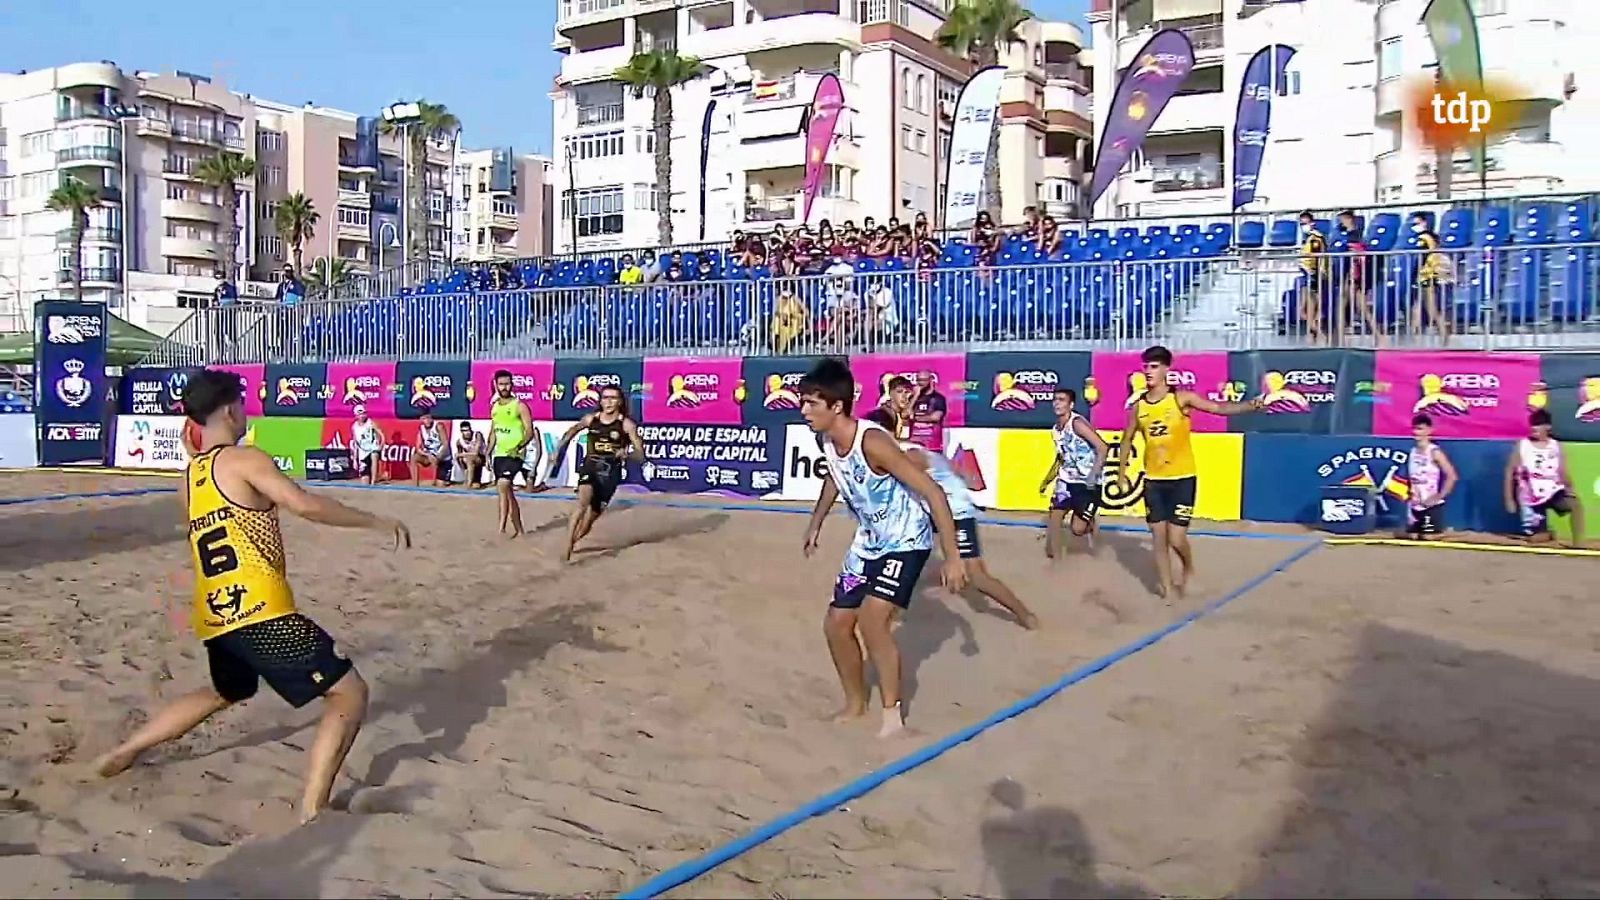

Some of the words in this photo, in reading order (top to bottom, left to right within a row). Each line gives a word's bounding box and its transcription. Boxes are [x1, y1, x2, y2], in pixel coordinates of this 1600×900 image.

[288, 377, 311, 387] ARENA
[355, 376, 381, 387] ARENA
[424, 375, 451, 386] ARENA
[512, 375, 534, 386] RENA
[588, 375, 621, 385] ARENA
[684, 374, 719, 385] ARENA
[1014, 371, 1059, 384] ARENA
[1166, 371, 1196, 384] ENA
[1284, 370, 1335, 384] ARENA
[1442, 374, 1500, 388] ARENA
[133, 381, 163, 391] MELILLA
[133, 393, 157, 402] SPORT
[697, 392, 718, 400] TOUR
[1304, 393, 1335, 401] TOUR
[133, 404, 164, 414] CAPITAL
[637, 426, 691, 442] PERCOPA
[694, 428, 713, 443] DE
[715, 426, 767, 444] ESPAÑA
[1149, 425, 1168, 437] 22
[153, 440, 179, 449] SPORT
[152, 452, 184, 461] CAPITAL
[671, 446, 713, 459] SPORT
[714, 447, 767, 462] CAPITAL
[790, 446, 829, 478] he
[1317, 447, 1408, 477] SPAGNO
[197, 526, 239, 578] 6
[882, 559, 903, 579] 31
